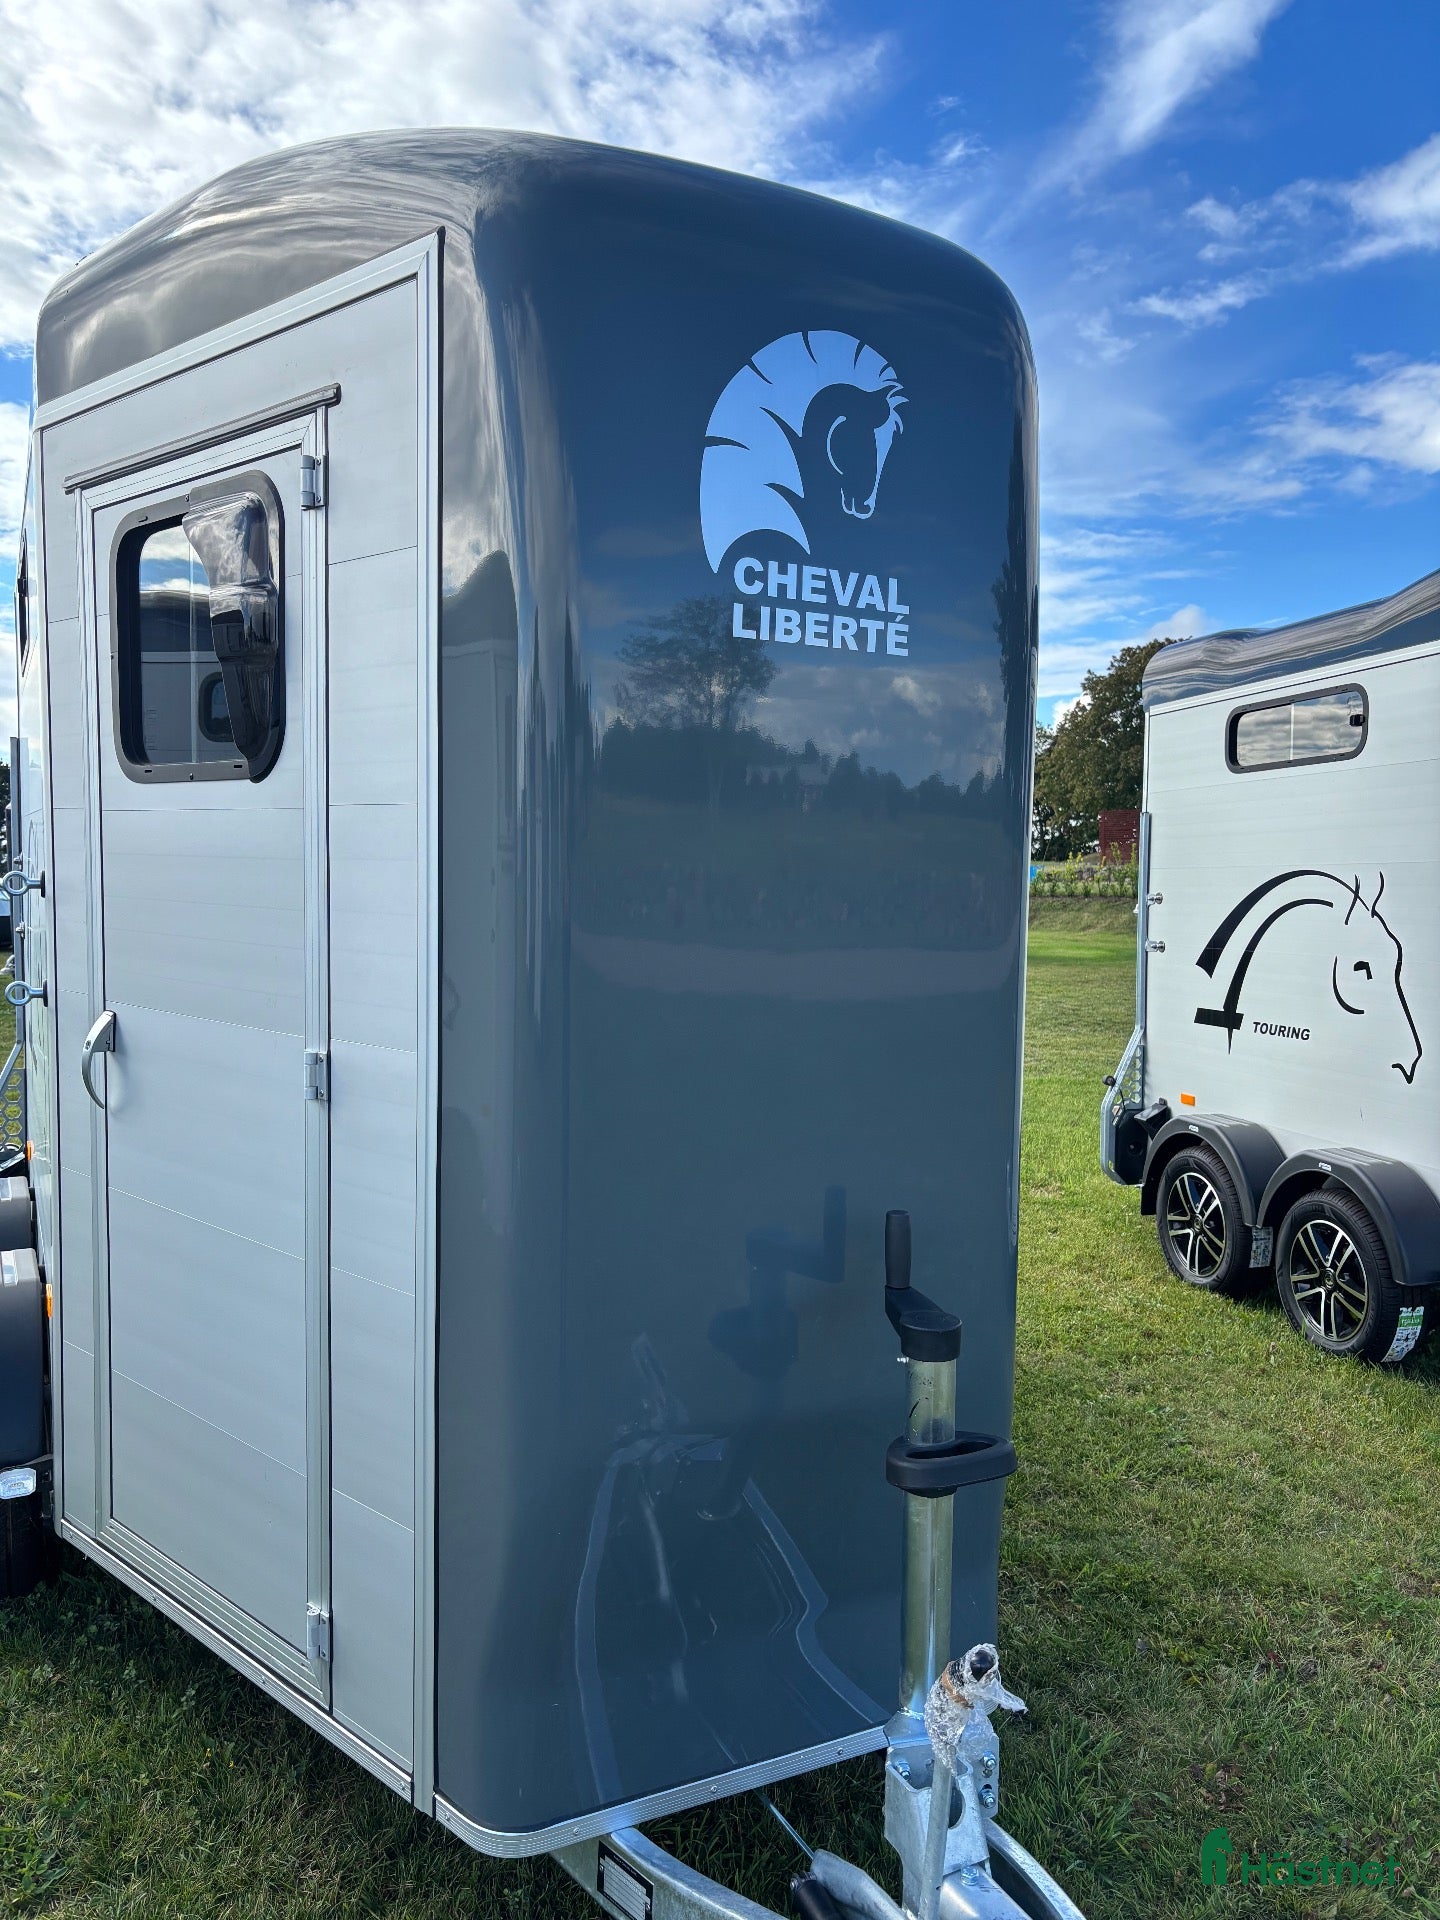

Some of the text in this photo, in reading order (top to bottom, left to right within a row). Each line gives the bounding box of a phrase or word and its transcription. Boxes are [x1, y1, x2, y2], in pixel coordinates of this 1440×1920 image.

[733, 557, 910, 615] CHEVAL
[732, 602, 909, 657] LIBERTÉ
[1252, 1021, 1311, 1041] TOURING
